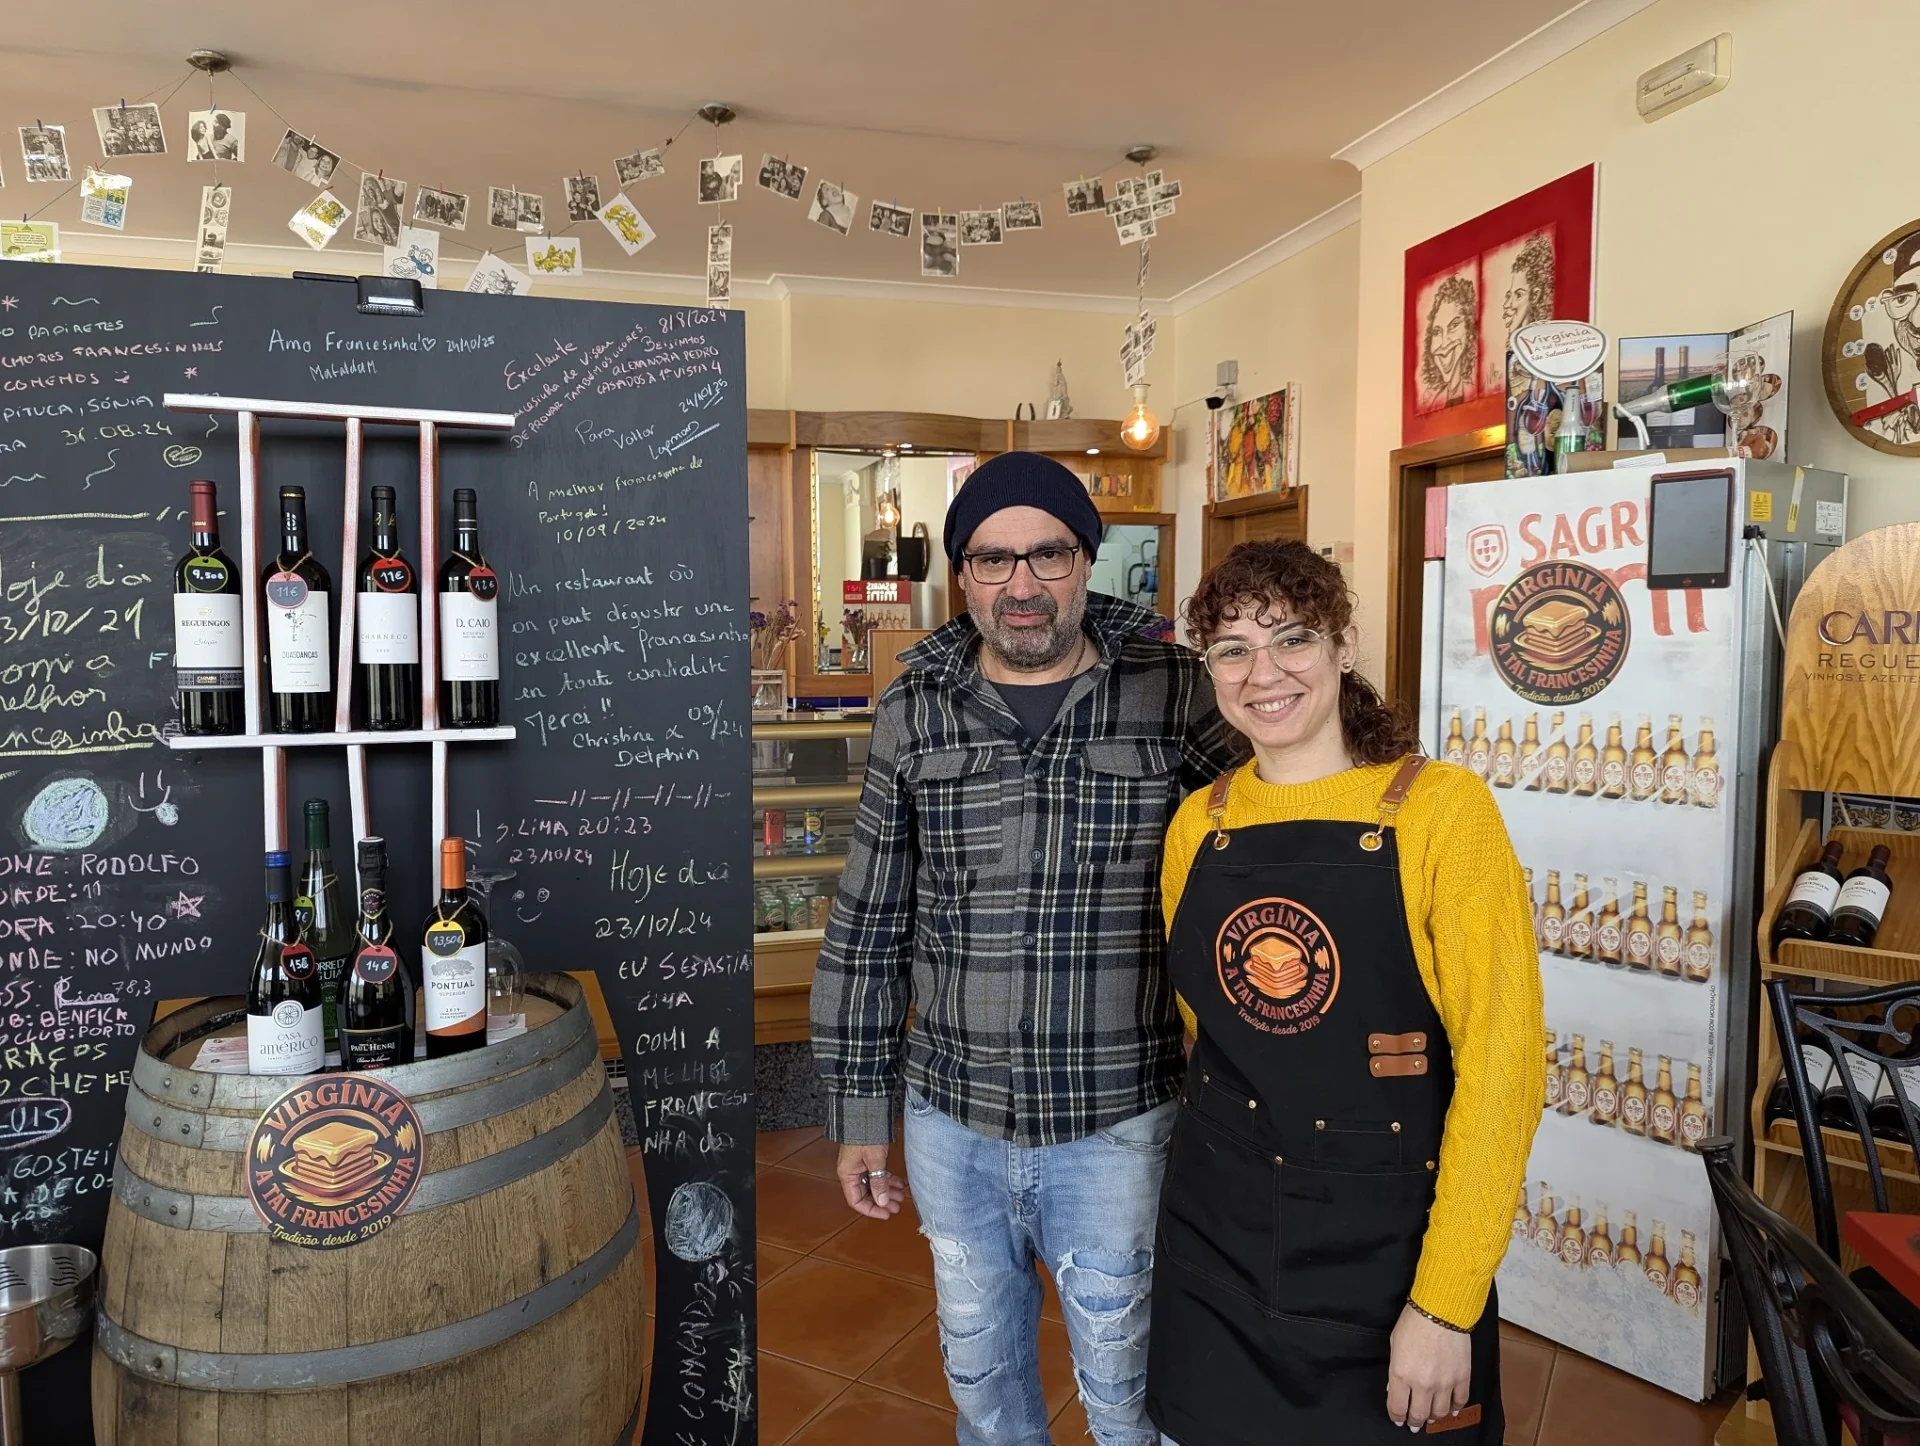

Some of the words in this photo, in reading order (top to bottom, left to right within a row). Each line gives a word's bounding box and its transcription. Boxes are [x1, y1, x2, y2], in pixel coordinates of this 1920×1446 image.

[658, 309, 728, 334] 8/8/2024
[268, 328, 312, 353] Amo
[682, 346, 720, 362] PEDRO
[1519, 328, 1591, 355] Virgínia
[509, 429, 530, 449] DE
[527, 400, 564, 434] PROVAR
[574, 419, 615, 446] Para
[527, 480, 540, 502] A
[1518, 498, 1650, 568] SAGR
[379, 569, 405, 584] 11€
[555, 565, 655, 592] restaurant
[1499, 564, 1613, 614] VIRGÍNIA
[276, 586, 299, 598] 11€
[181, 618, 231, 628] REGUENGOS
[511, 620, 540, 634] on
[549, 605, 593, 636] peut
[694, 602, 735, 616] une
[1818, 610, 1920, 646] CAR
[361, 633, 409, 641] CHARNECO
[1496, 641, 1511, 655] A
[1503, 653, 1527, 687] TAL
[1527, 629, 1623, 690] FRANCESINHA
[1512, 683, 1551, 703] Tradição
[1552, 692, 1581, 704] desde
[1581, 677, 1608, 699] 2019
[1803, 672, 1853, 682] VINHOS
[1858, 673, 1866, 682] E
[514, 685, 547, 701] en
[572, 724, 655, 749] Christine
[614, 747, 700, 769] Delphin
[578, 814, 653, 836] 20:23
[81, 852, 200, 877] RODOLFO
[594, 906, 713, 940] 23/10/24
[1225, 903, 1322, 949] VIRGÍNIA
[85, 948, 119, 967] NO
[135, 935, 213, 962] MUNDO
[431, 979, 475, 990] PONTUAL
[1224, 966, 1240, 981] A
[1232, 979, 1254, 1007] TAL
[1253, 972, 1330, 1021] FRANCESINHA
[40, 1007, 128, 1028] BENFICA
[78, 1023, 136, 1039] PORTO
[1237, 1006, 1271, 1033] Tradição
[1271, 1023, 1299, 1036] desde
[1299, 1014, 1322, 1032] 2019
[277, 1031, 302, 1041] CASA
[635, 1025, 687, 1056] COMI
[704, 1026, 721, 1051] A
[0, 1041, 109, 1074] RAÇOS
[263, 1079, 406, 1133] VIRGÍNIA
[13, 1141, 114, 1179] GOSTEI
[255, 1169, 274, 1187] A
[261, 1182, 293, 1219] TAL
[289, 1155, 416, 1230] FRANCESINHA
[271, 1222, 320, 1247] Tradição
[322, 1231, 359, 1247] desde
[360, 1213, 393, 1239] 2019
